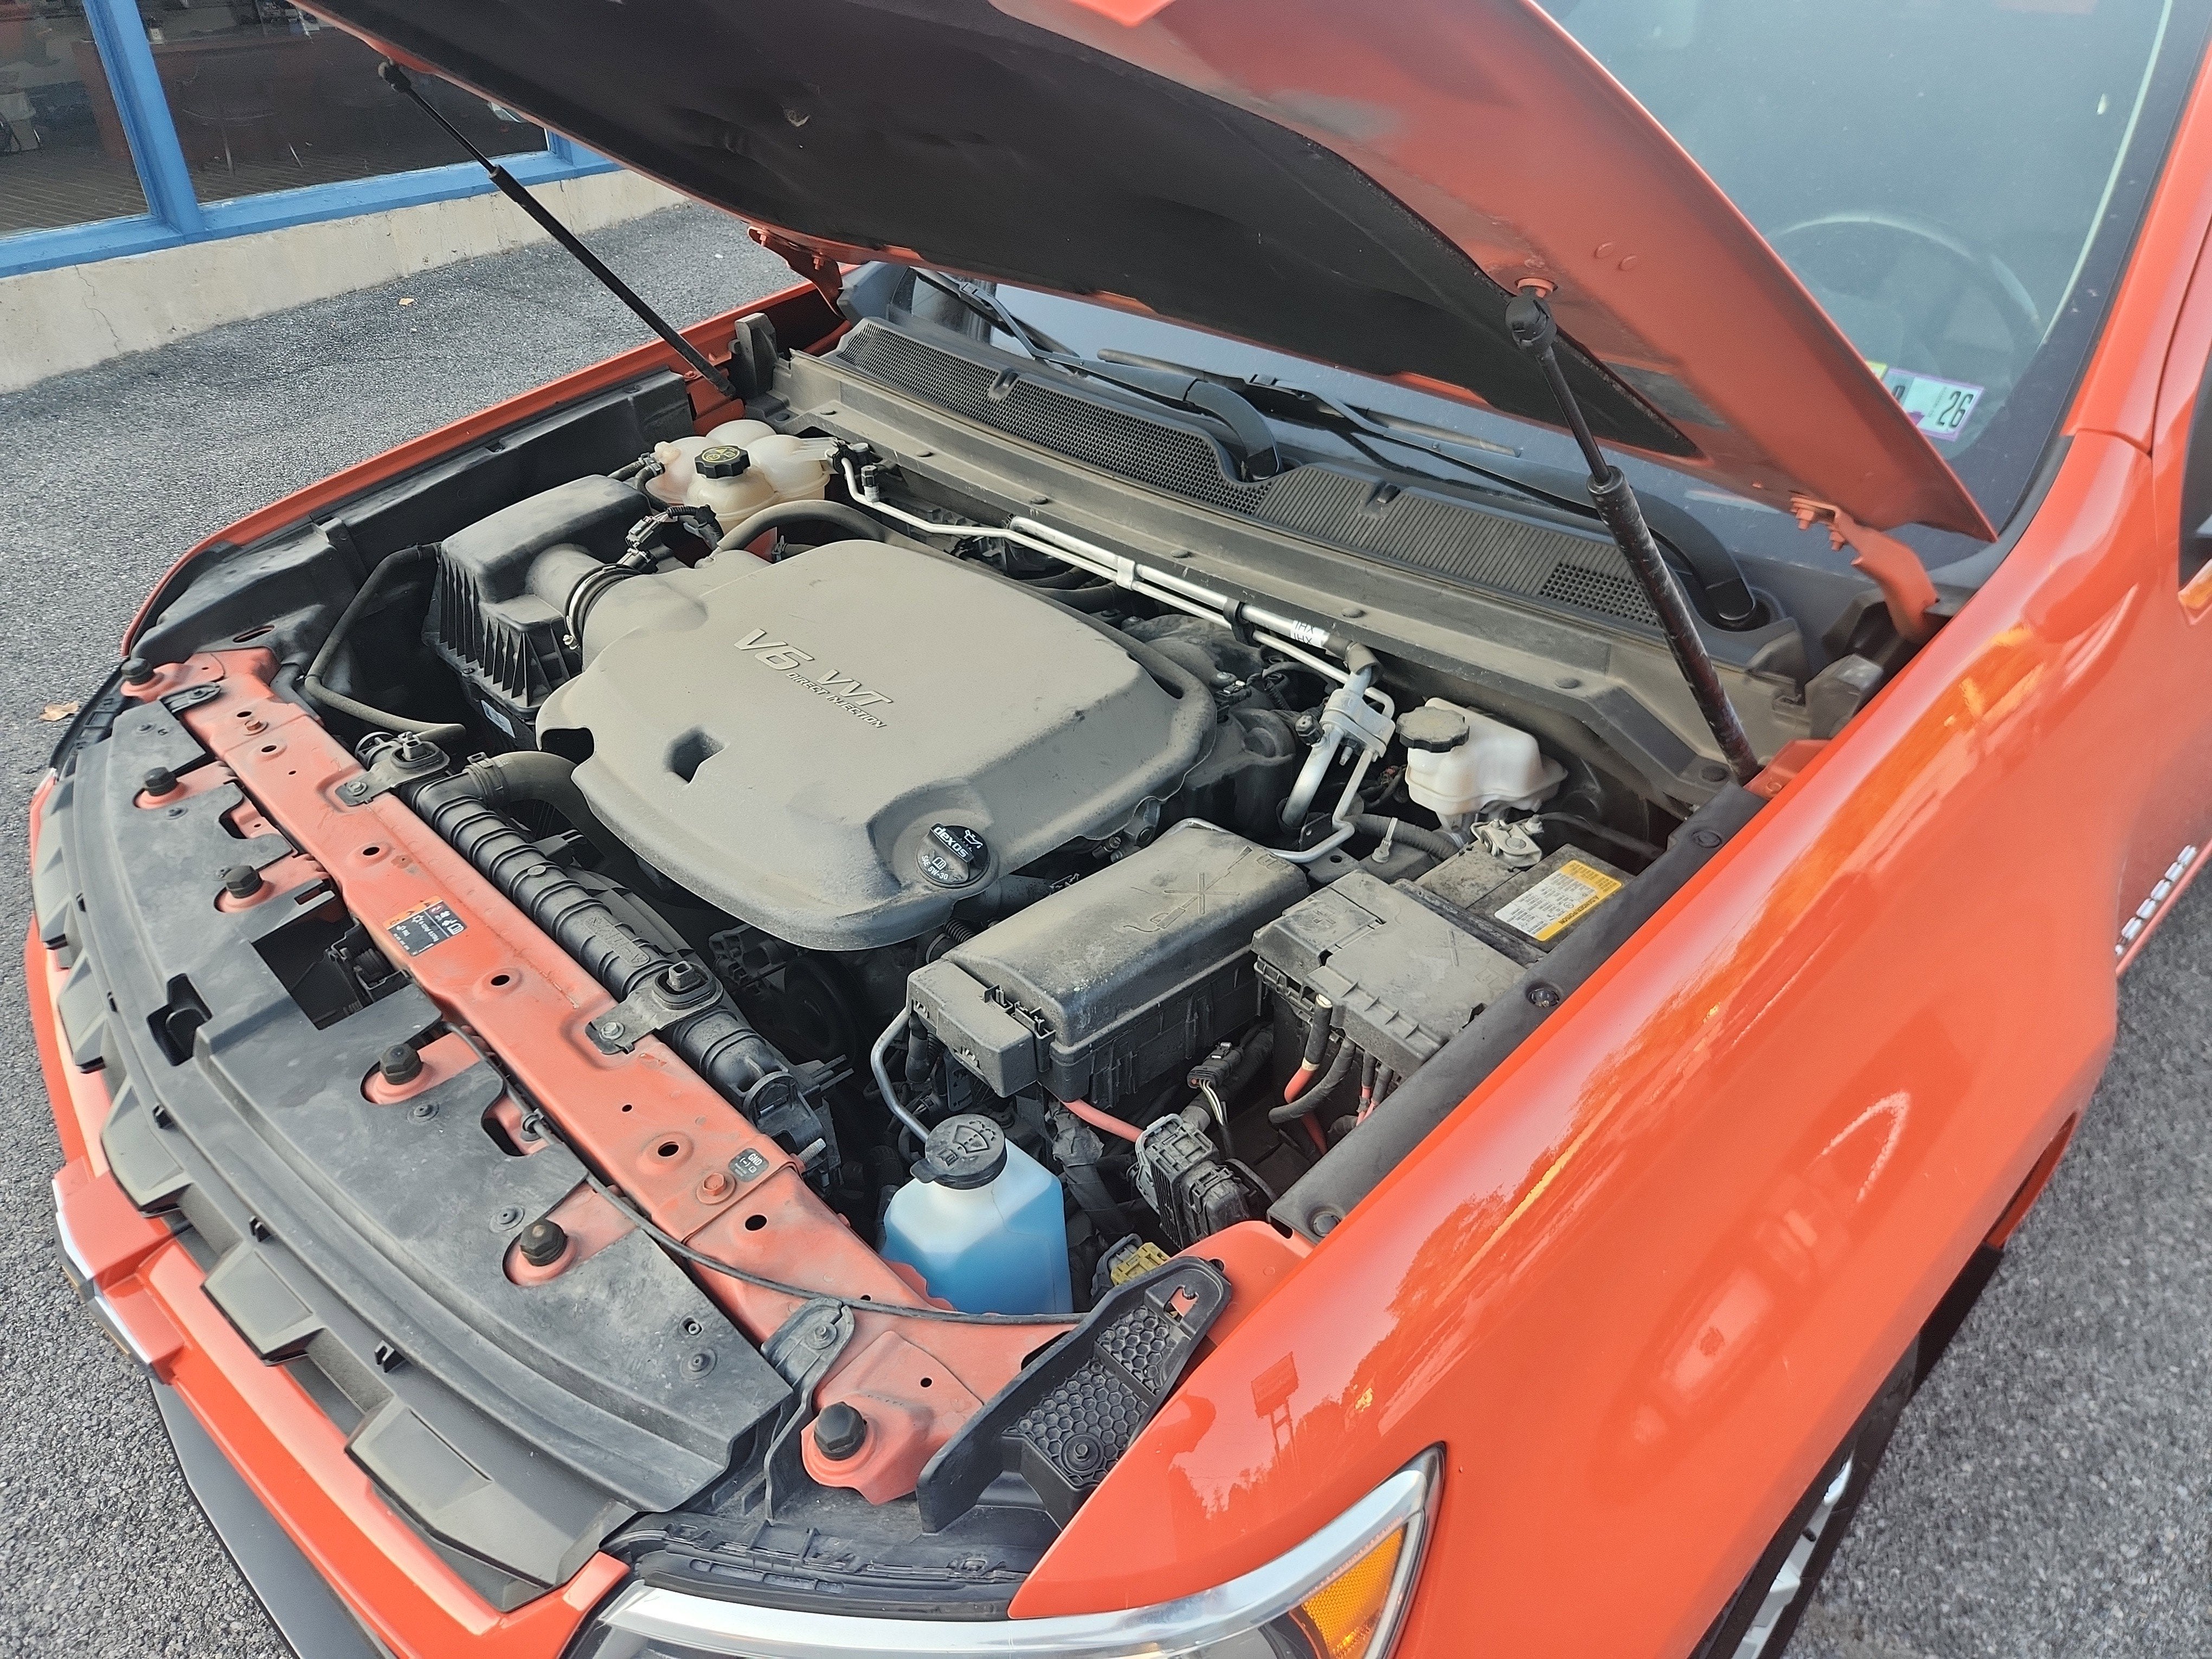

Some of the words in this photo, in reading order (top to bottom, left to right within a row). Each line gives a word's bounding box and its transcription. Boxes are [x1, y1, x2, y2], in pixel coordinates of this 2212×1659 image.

[1935, 390, 1974, 428] 26
[734, 628, 814, 671] V6
[816, 669, 894, 706] VVT
[786, 672, 829, 696] DIRECT
[826, 695, 888, 729] INJECTION
[934, 826, 969, 858] dexos
[922, 855, 931, 867] SAE
[928, 865, 949, 880] 5W-30
[748, 1153, 763, 1166] GND
